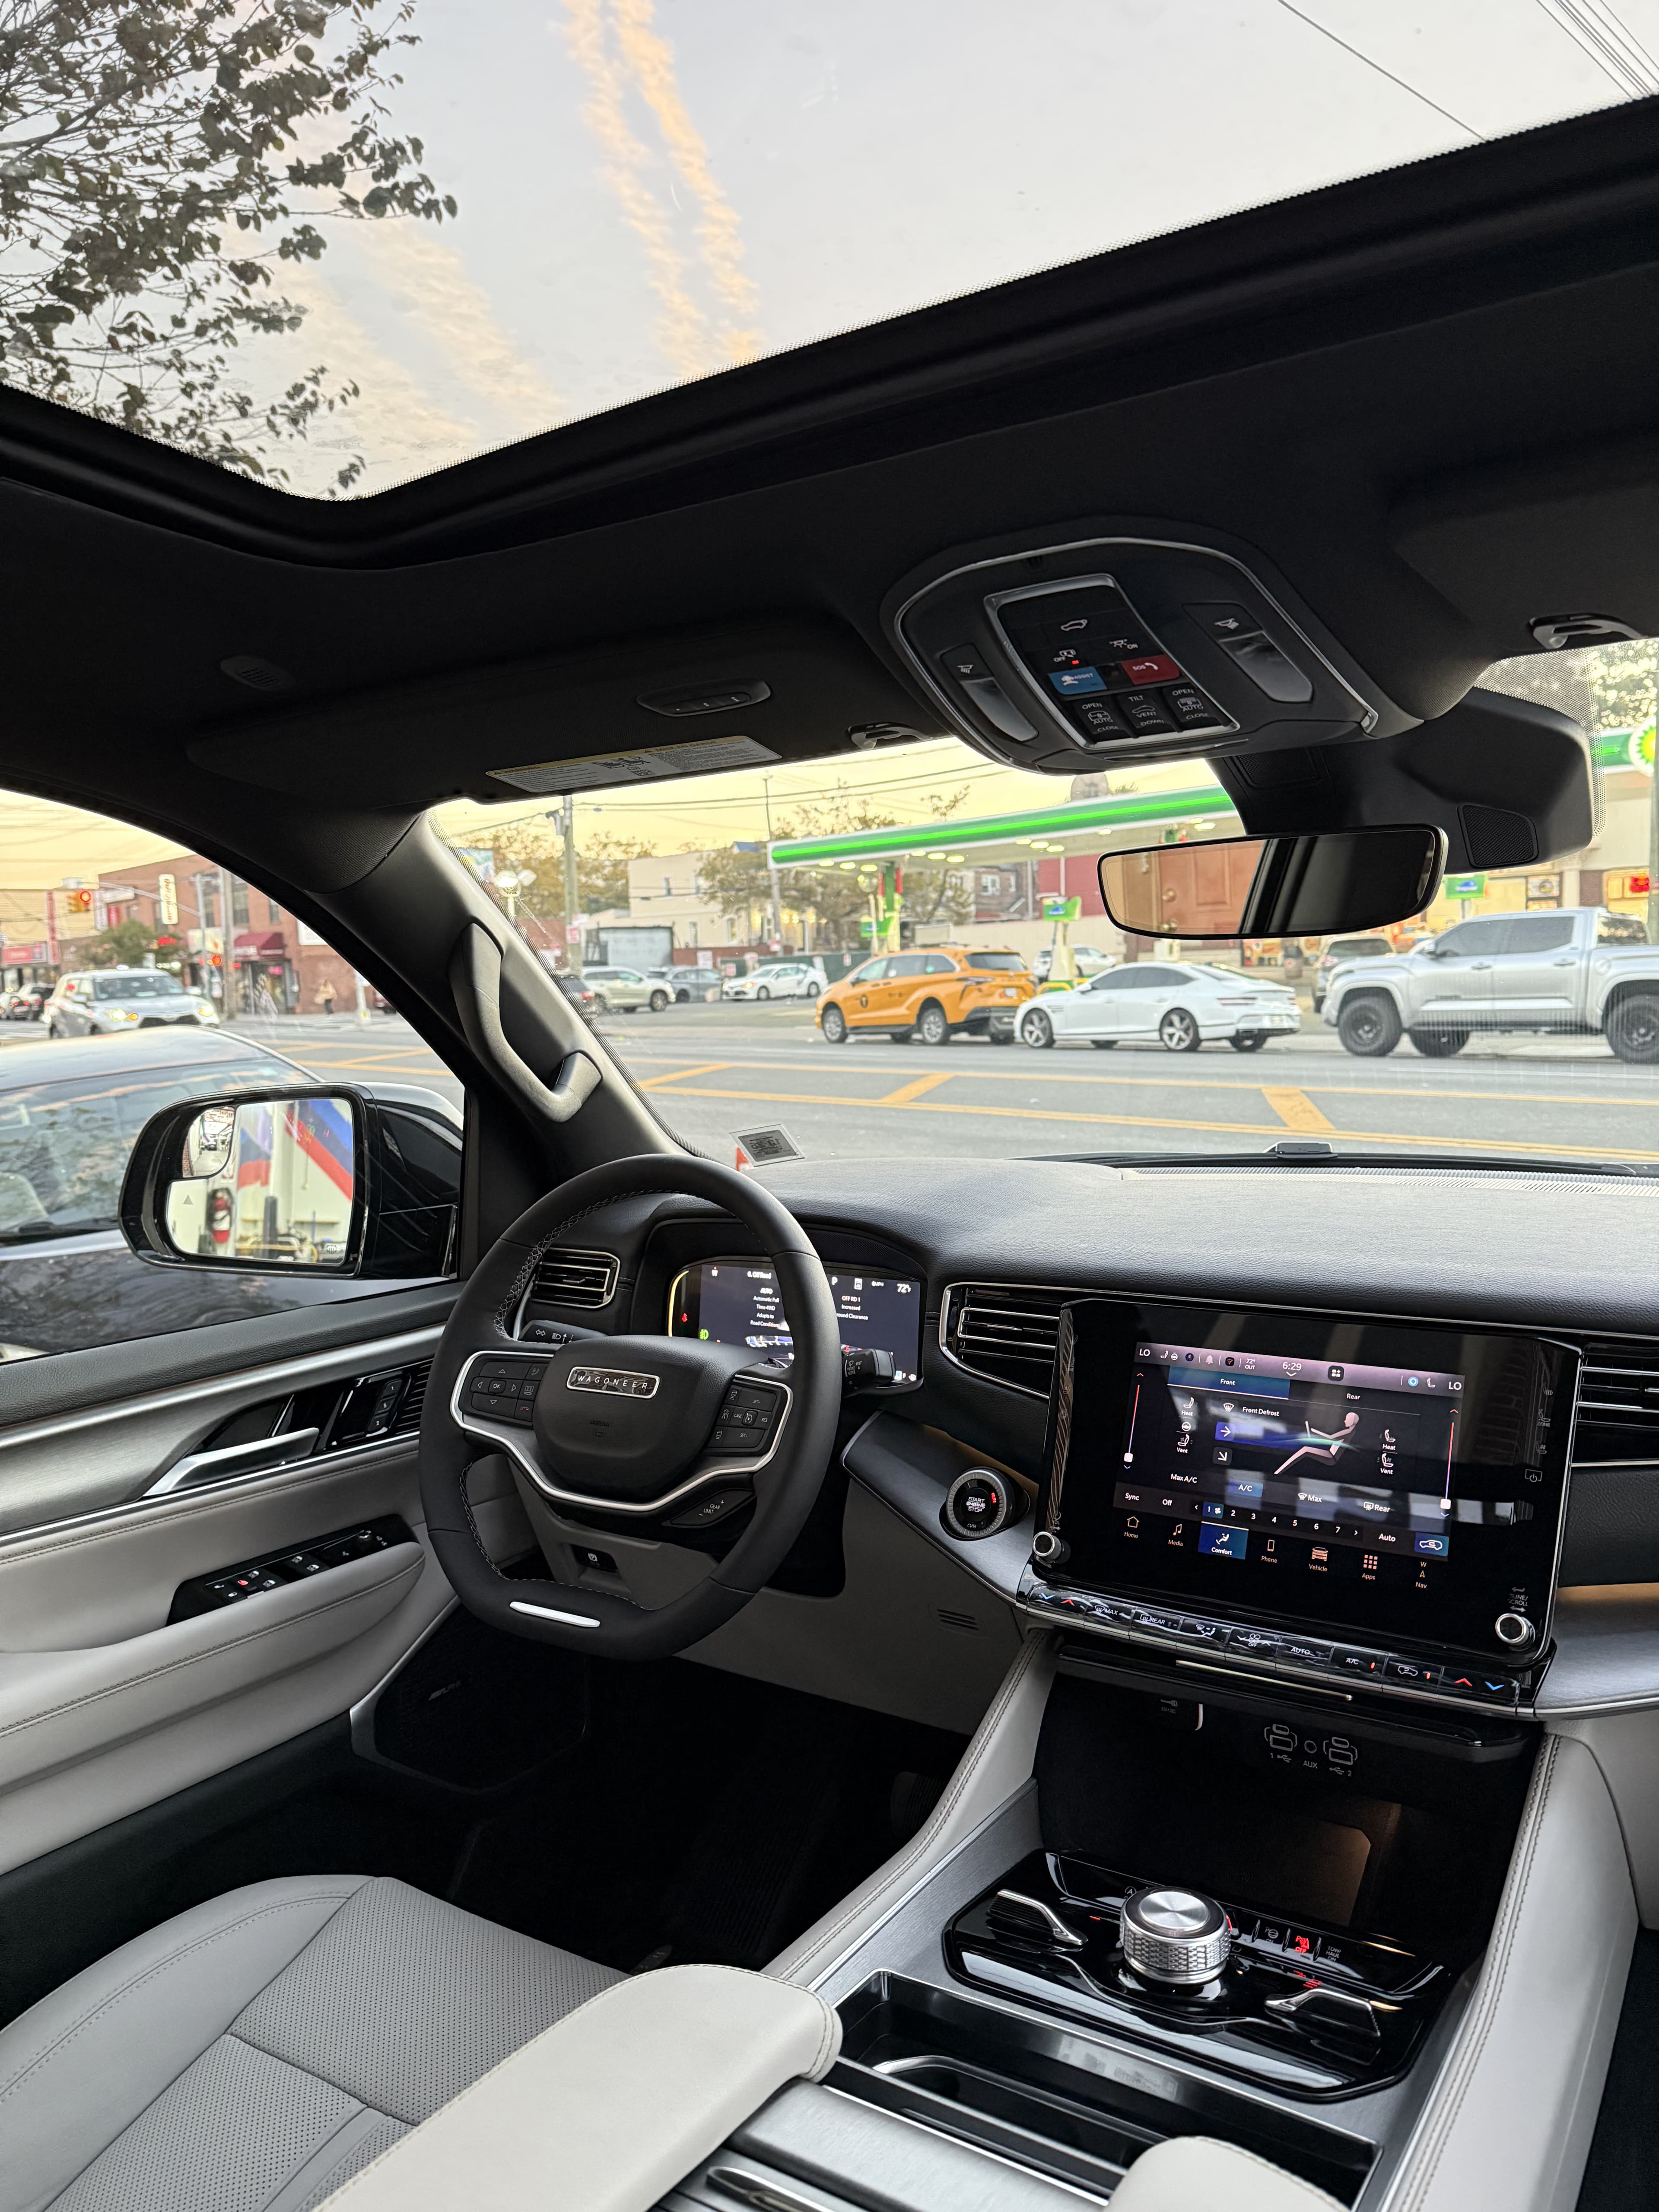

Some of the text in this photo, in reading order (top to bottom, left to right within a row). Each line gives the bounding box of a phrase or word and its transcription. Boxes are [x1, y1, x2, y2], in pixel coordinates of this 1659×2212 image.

[831, 1276, 838, 1286] P
[1139, 1348, 1150, 1357] LO
[1282, 1361, 1302, 1371] 6:29
[578, 1375, 648, 1389] WAGONEER
[1448, 1381, 1462, 1390] LO
[1258, 1408, 1280, 1417] Defrost
[1170, 1473, 1198, 1484] Max A/C
[1125, 1493, 1140, 1501] Sync
[1308, 1494, 1322, 1503] Max
[1374, 1504, 1391, 1513] Rear
[1378, 1533, 1396, 1542] Auto
[1211, 1547, 1233, 1555] Comfort
[1309, 1563, 1328, 1572] Vehicle
[1290, 1646, 1310, 1655] AUTO
[1303, 1760, 1318, 1769] AUX
